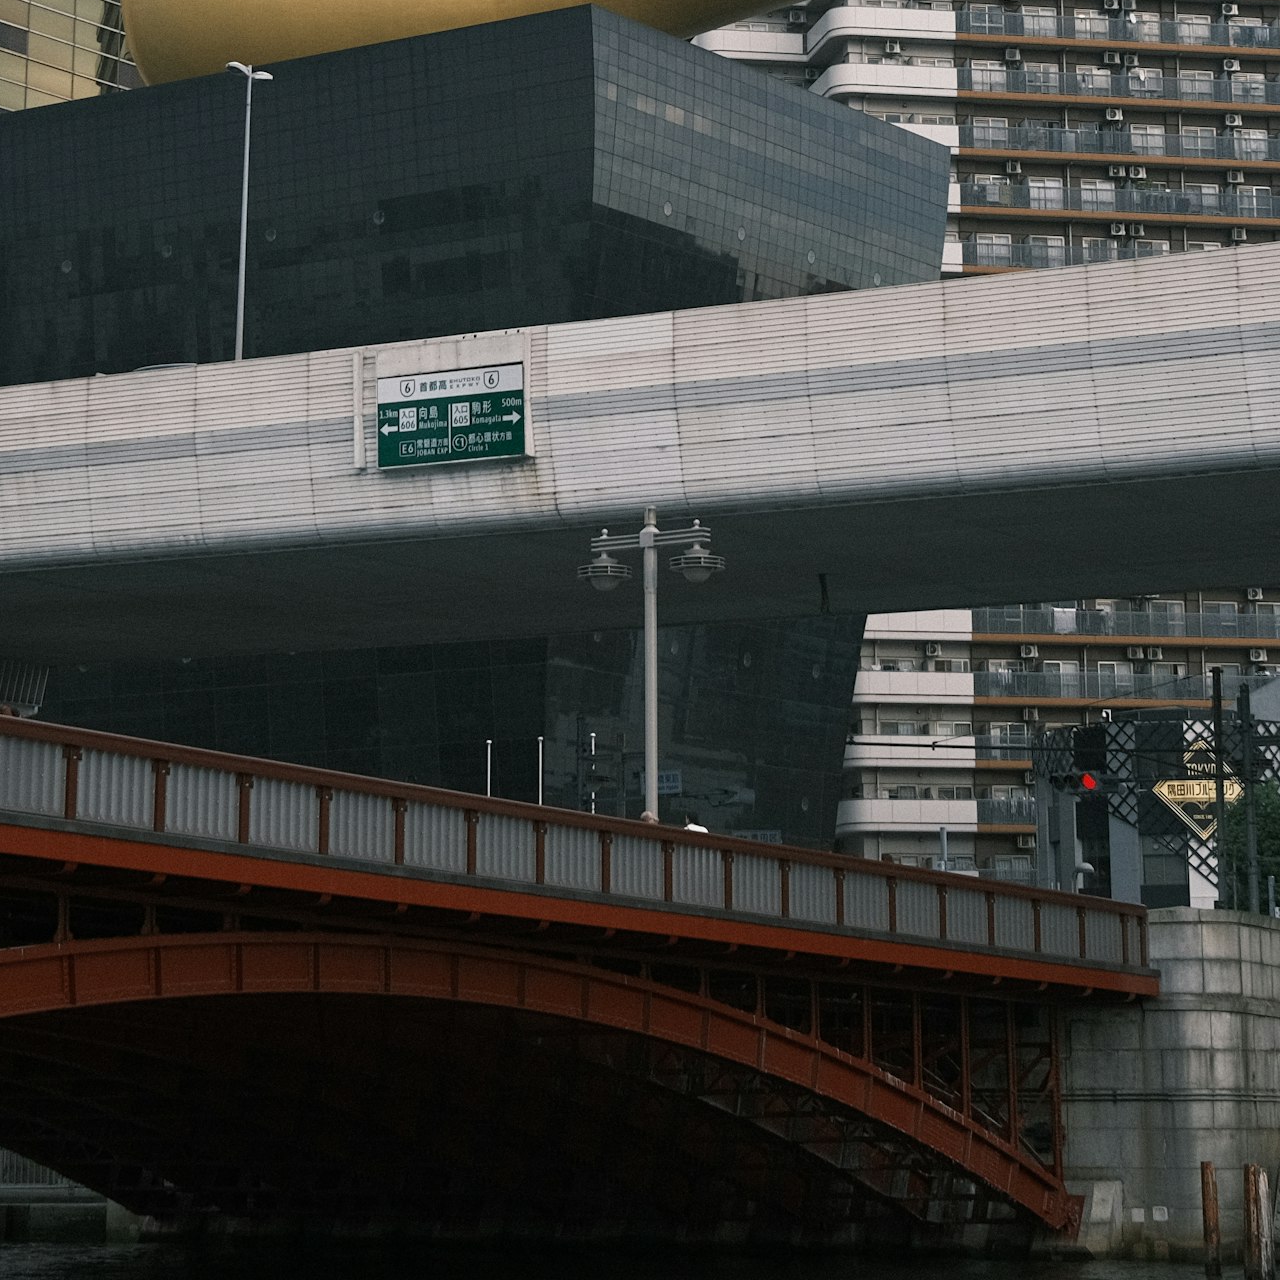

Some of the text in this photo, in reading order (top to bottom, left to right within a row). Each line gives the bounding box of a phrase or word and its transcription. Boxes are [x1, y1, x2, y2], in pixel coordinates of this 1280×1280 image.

[488, 374, 495, 385] 6
[404, 380, 447, 394] 6 首都高
[472, 400, 491, 415] 駒形
[502, 398, 522, 407] 500m
[380, 409, 398, 419] 1.3km
[401, 410, 415, 419] 入口
[419, 406, 438, 420] 向島
[454, 405, 468, 414] 入口
[401, 420, 415, 429] 606
[419, 419, 447, 430] Mukojima
[453, 415, 468, 424] 605
[472, 414, 501, 425] Komagata
[402, 443, 414, 454] E6
[417, 448, 435, 457] JOBAN
